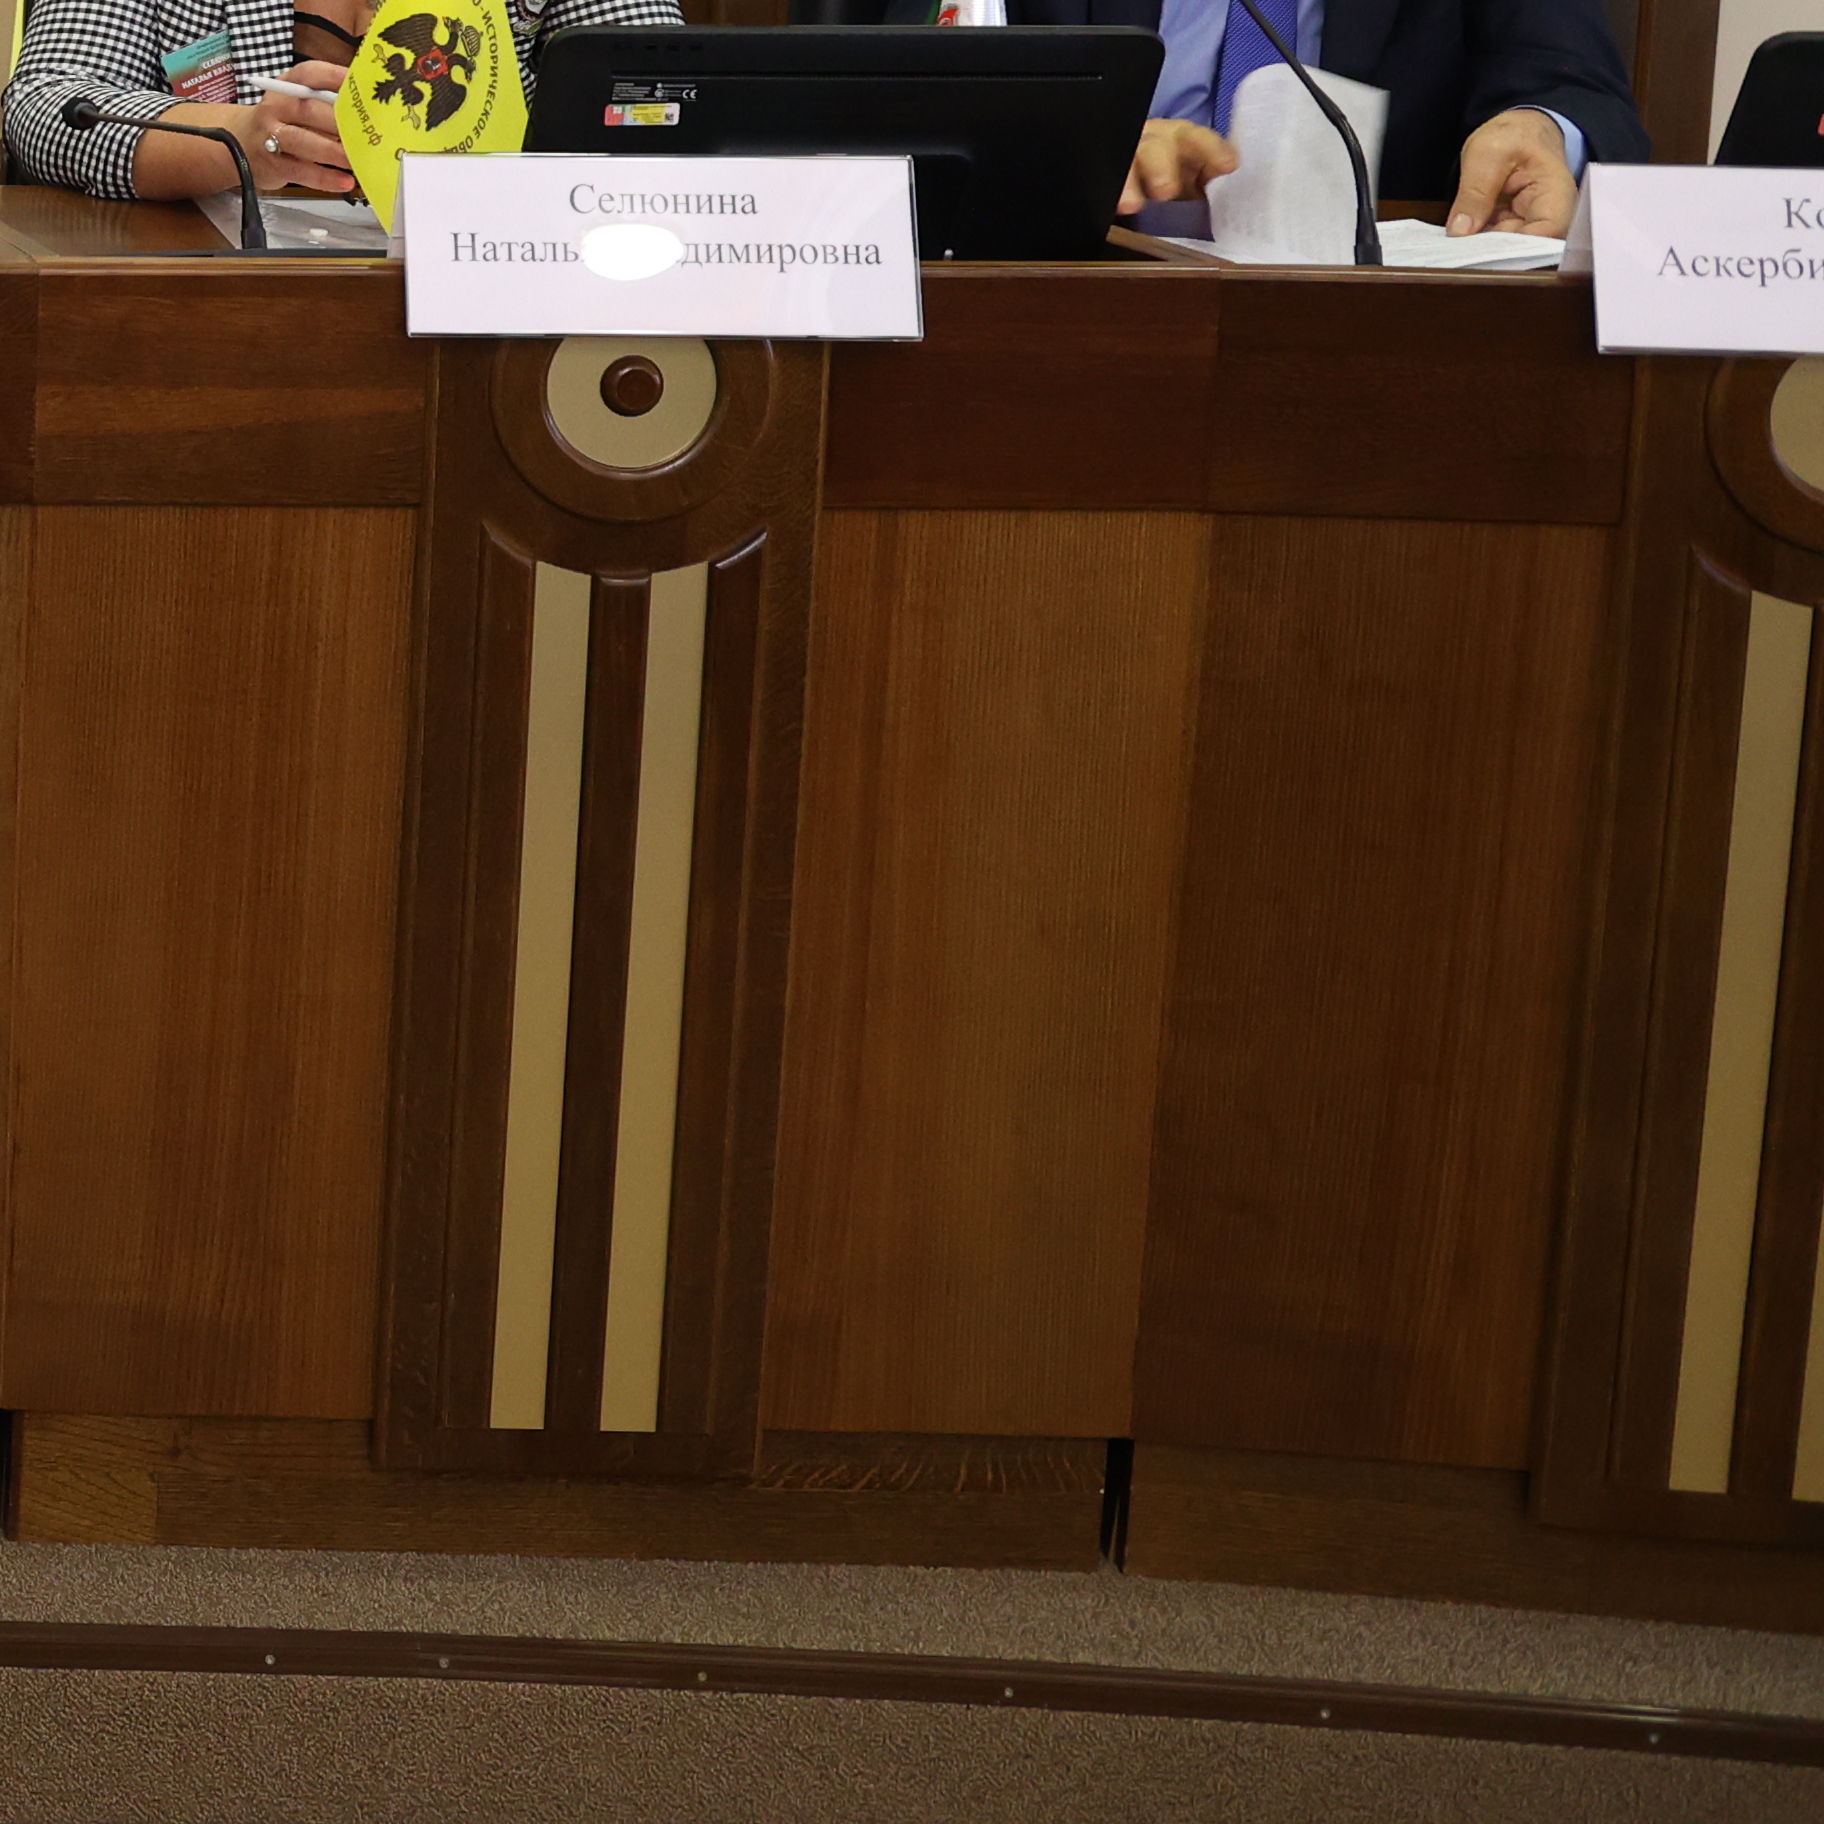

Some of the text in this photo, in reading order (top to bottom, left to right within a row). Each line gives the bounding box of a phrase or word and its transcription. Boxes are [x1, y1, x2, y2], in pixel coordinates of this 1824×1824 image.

[569, 183, 760, 215] Селюнина
[449, 232, 884, 274] Наталь димировна
